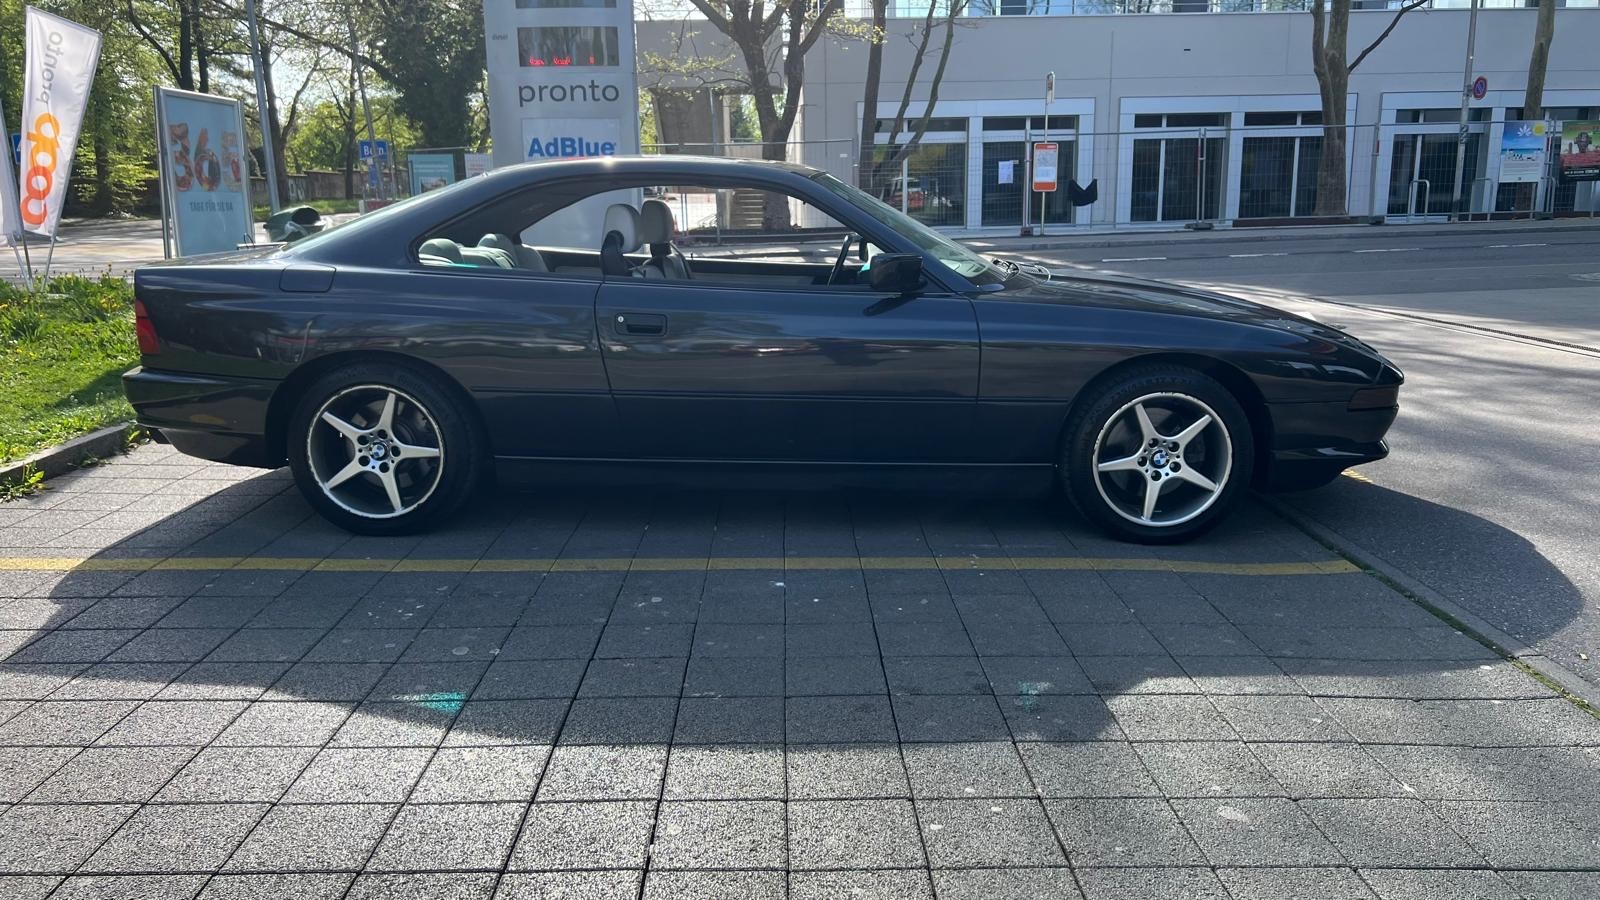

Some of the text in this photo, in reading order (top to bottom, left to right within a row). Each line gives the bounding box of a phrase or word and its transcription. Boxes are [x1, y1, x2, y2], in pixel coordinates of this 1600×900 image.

[518, 80, 620, 108] pronto
[169, 123, 242, 193] 365
[528, 136, 616, 158] AdBlue
